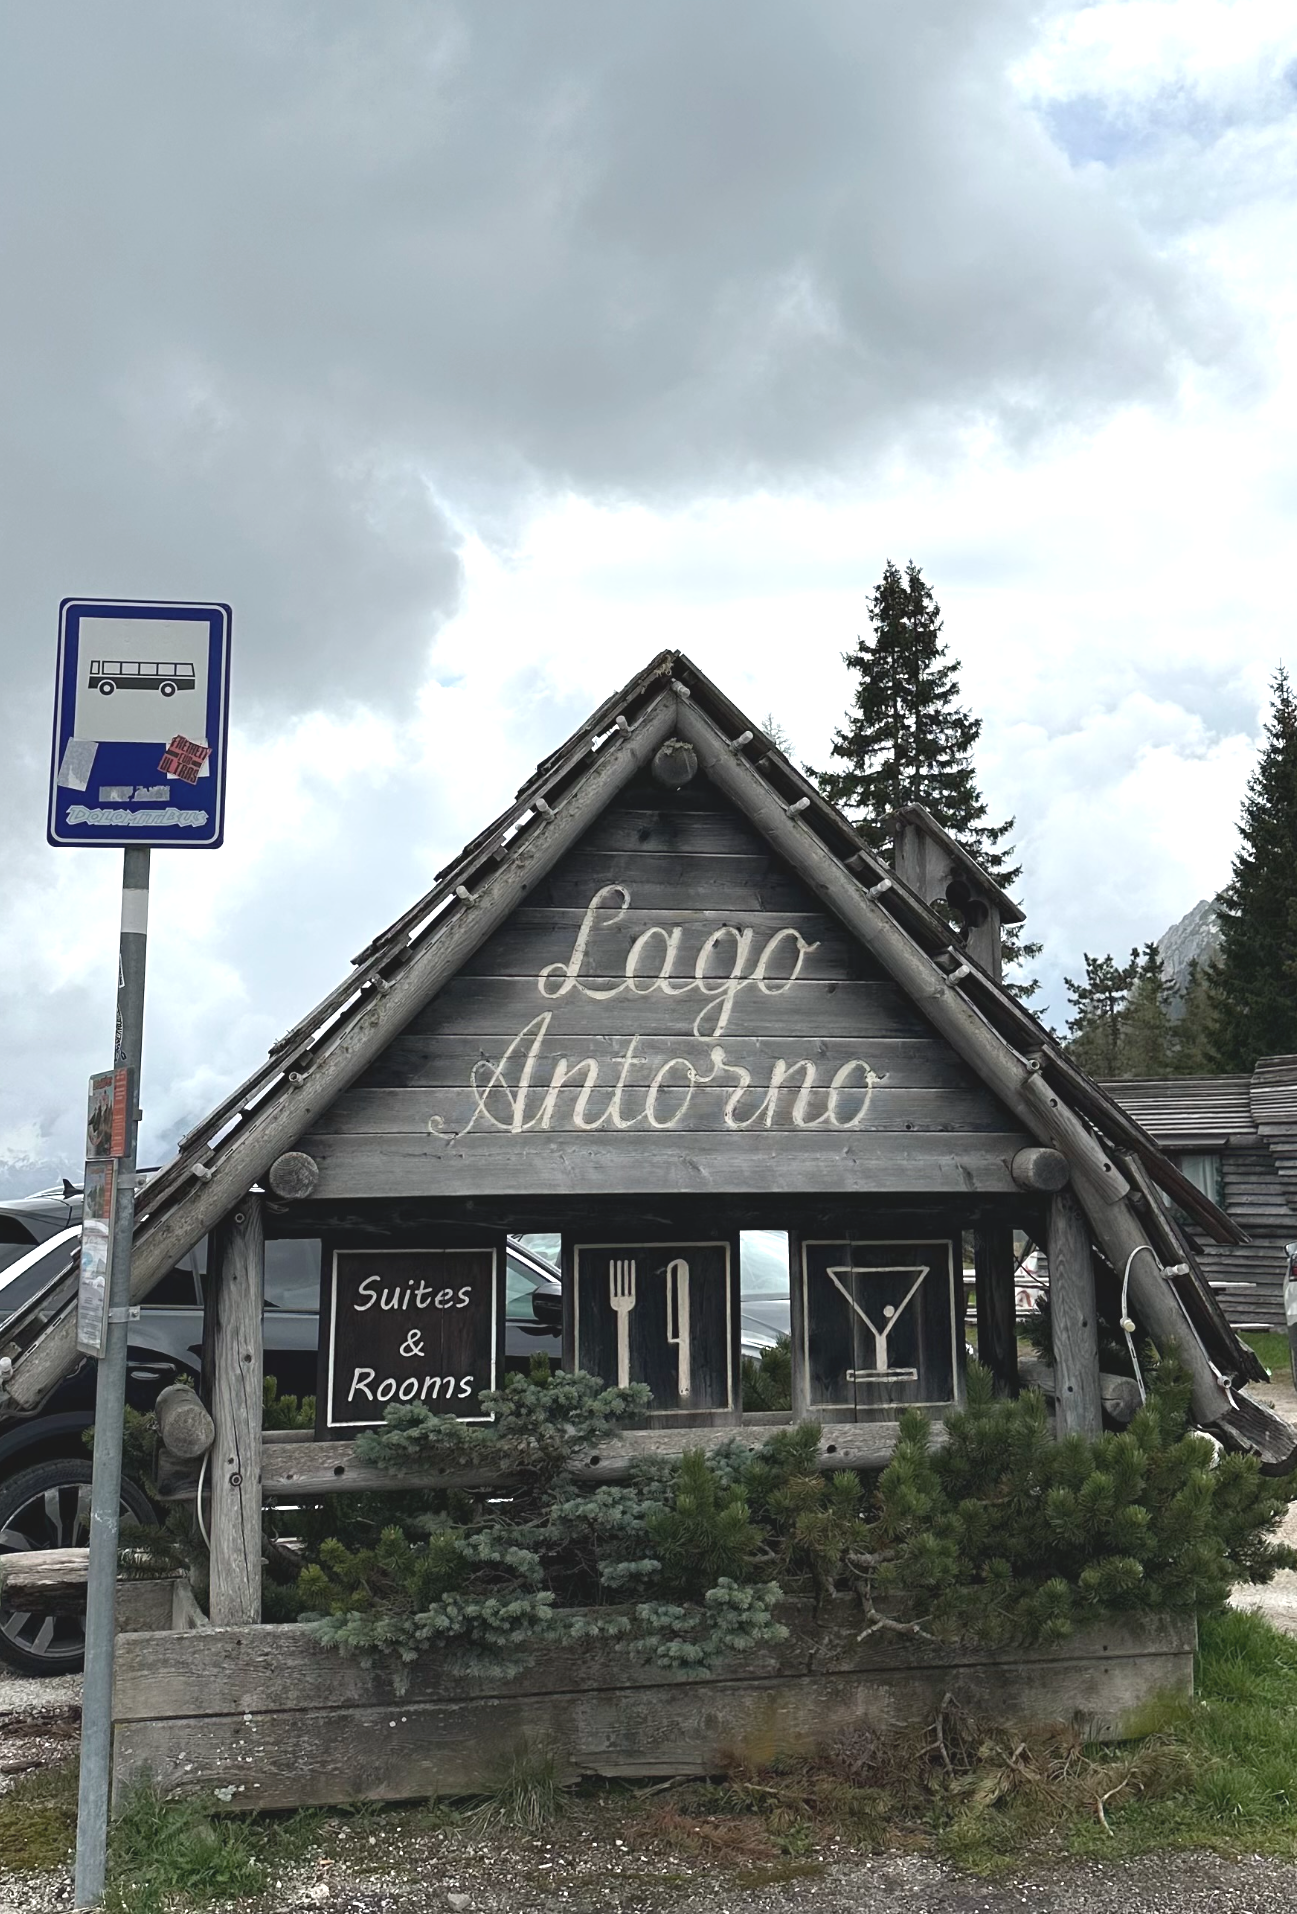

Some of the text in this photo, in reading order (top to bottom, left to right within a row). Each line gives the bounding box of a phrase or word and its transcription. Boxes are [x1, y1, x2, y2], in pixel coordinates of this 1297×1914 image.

[538, 884, 821, 1037] Lago
[428, 1011, 890, 1139] Antorno
[353, 1275, 472, 1311] Suites
[400, 1329, 425, 1357] &
[348, 1367, 474, 1402] Rooms
